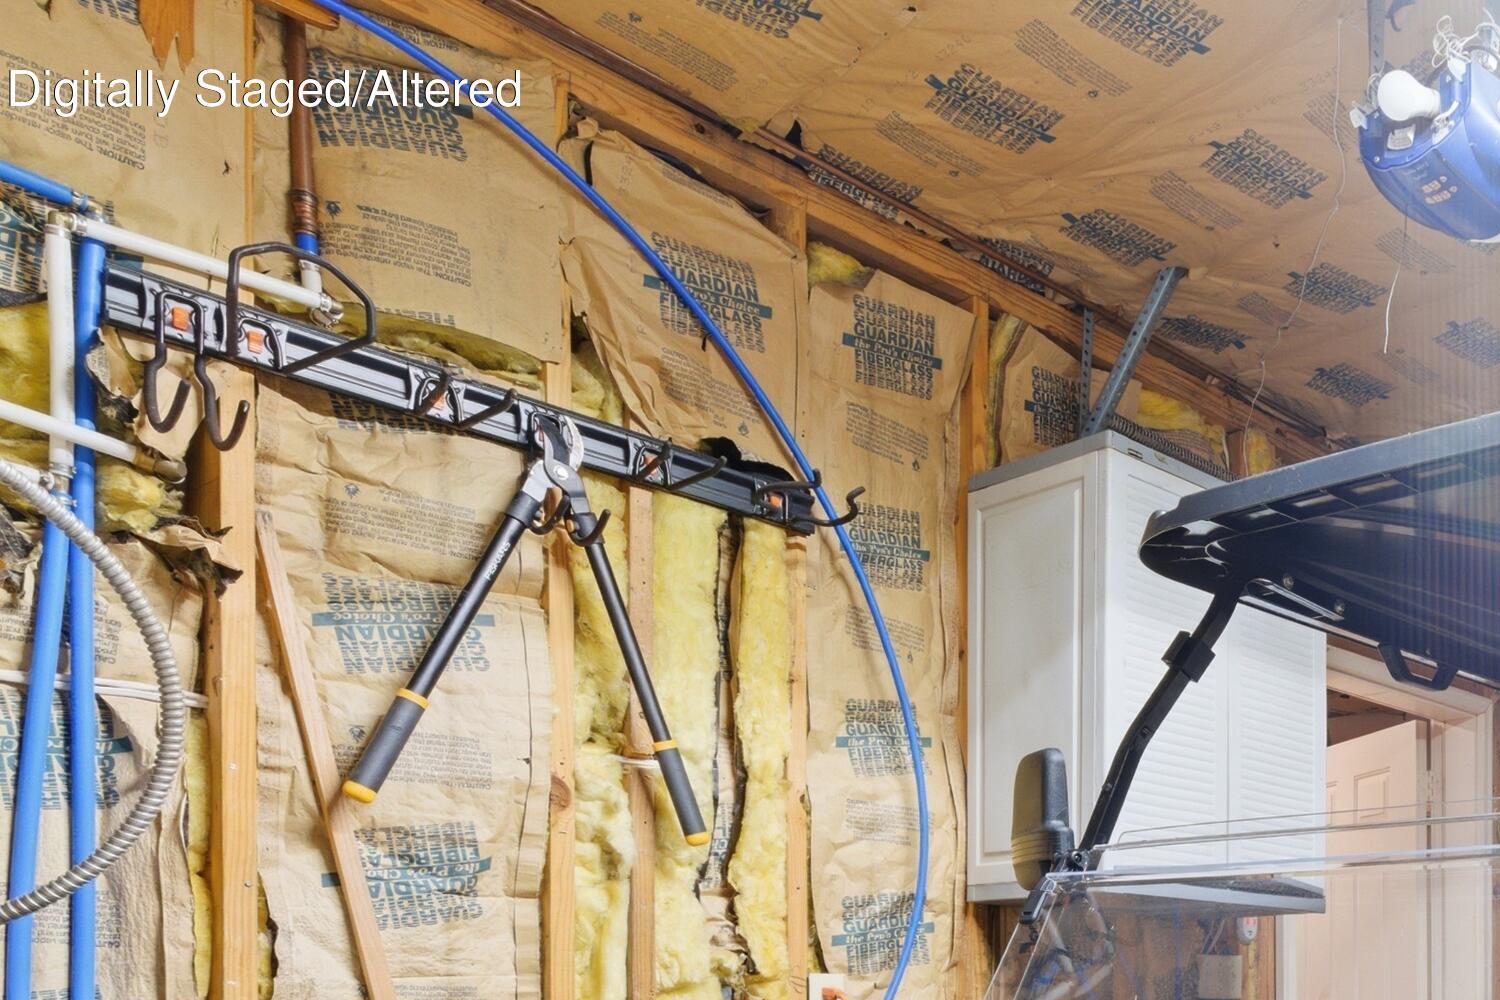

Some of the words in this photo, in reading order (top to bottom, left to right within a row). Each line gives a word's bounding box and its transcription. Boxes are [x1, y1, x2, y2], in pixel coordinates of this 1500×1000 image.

[672, 264, 760, 303] UARDIAN
[853, 293, 935, 329] GUARDIAN
[854, 322, 934, 356] GUARDIAN
[855, 349, 933, 379] FIBERGLASS
[856, 503, 920, 524] UARDIAN
[849, 527, 921, 550] GUARDIAN
[857, 553, 924, 571] IBERGLASS
[333, 611, 394, 625] Choice
[334, 624, 482, 642] GRDIAN
[845, 699, 916, 713] GUARDIN
[367, 848, 481, 868] FIBERGLA
[368, 876, 479, 898] GUARDIA
[841, 891, 916, 910] GUARDIA
[376, 903, 484, 931] GUARDIA
